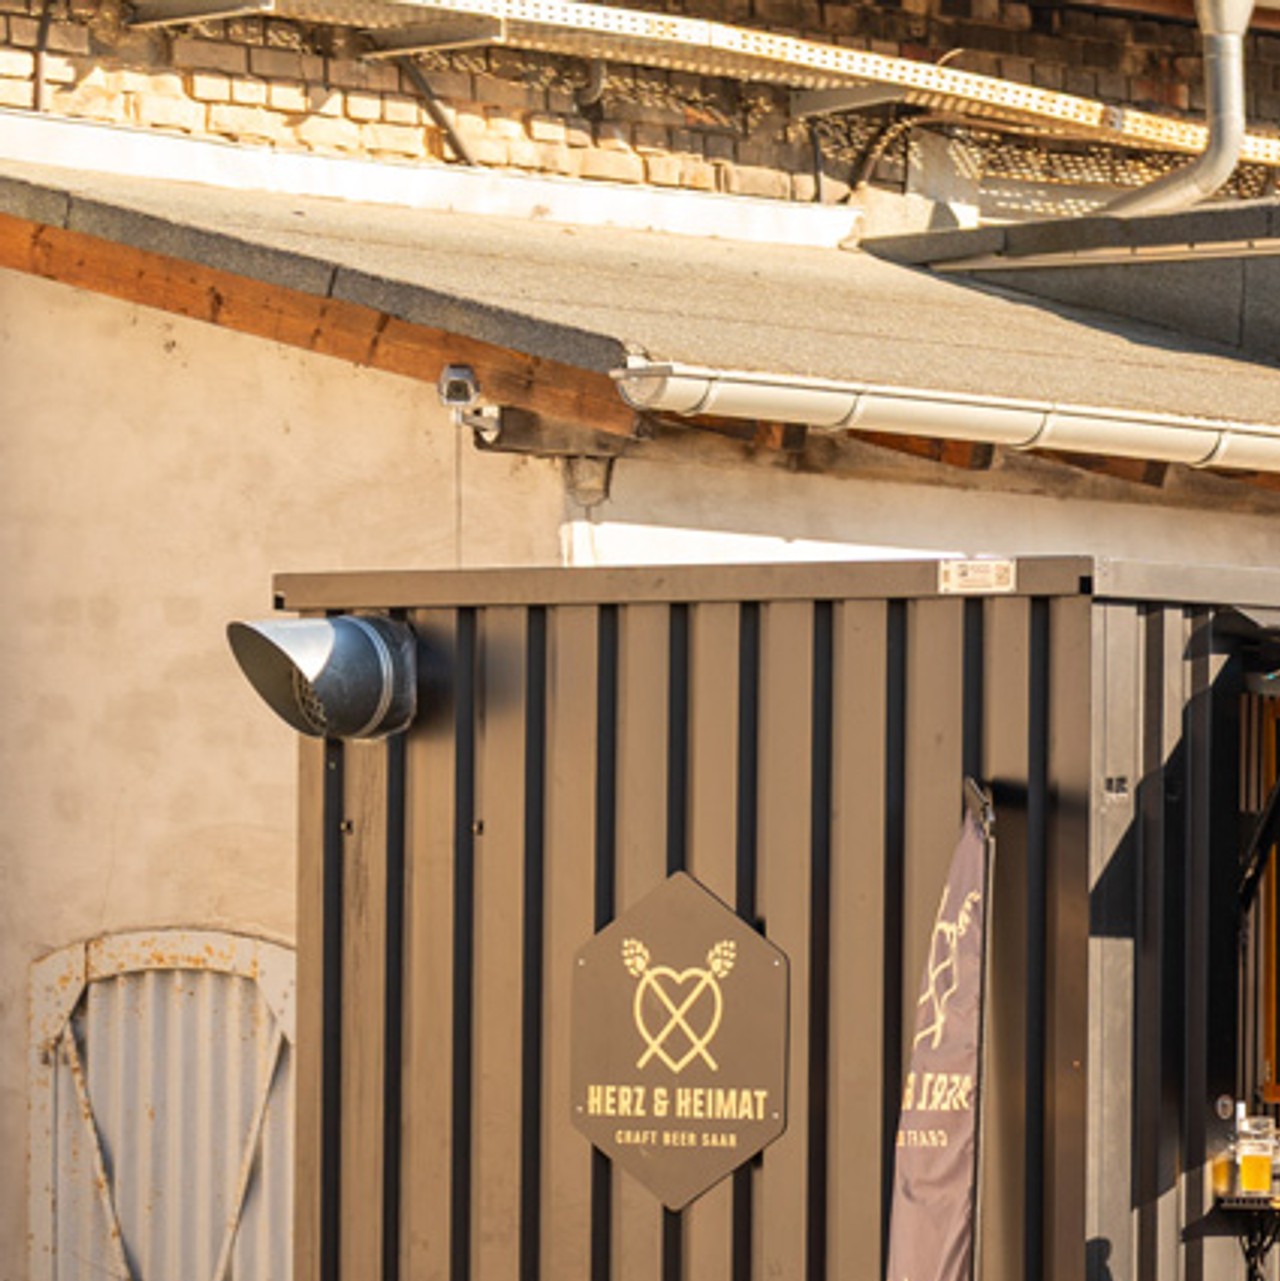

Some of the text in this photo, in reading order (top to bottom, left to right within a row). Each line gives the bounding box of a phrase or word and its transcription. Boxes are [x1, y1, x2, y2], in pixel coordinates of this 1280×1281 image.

[588, 1085, 768, 1121] HERZ & HEIMAT
[615, 1129, 658, 1145] CRAFT
[662, 1131, 697, 1147] BEER
